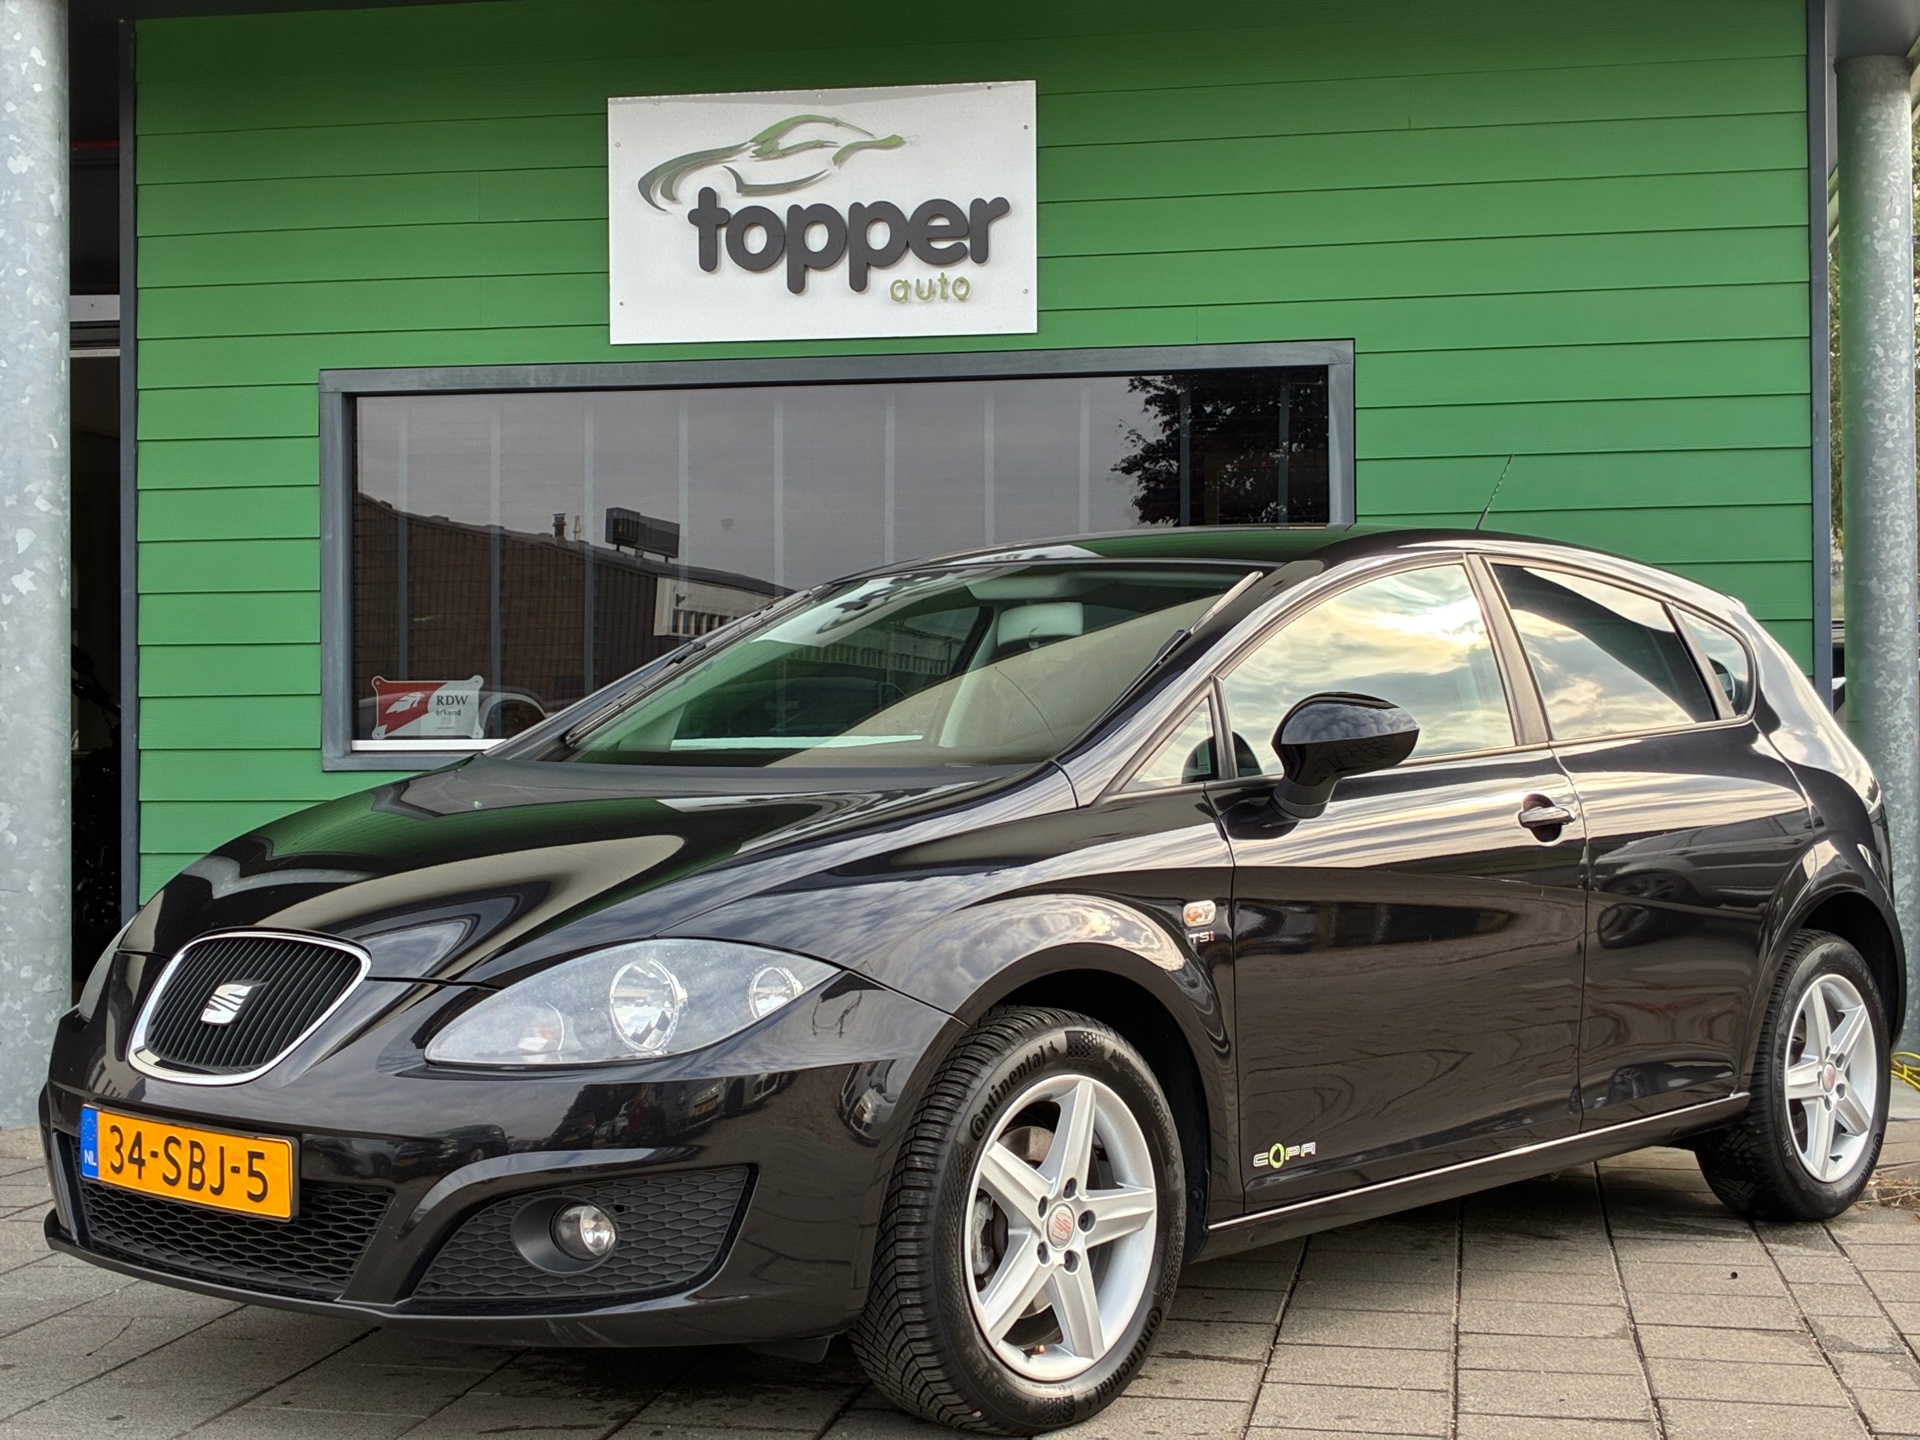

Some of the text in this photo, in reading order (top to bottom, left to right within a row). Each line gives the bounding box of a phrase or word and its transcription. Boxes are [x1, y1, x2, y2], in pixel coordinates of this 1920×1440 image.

[688, 187, 1011, 294] topper
[890, 272, 971, 301] auto
[436, 695, 468, 706] RDW
[436, 709, 462, 717] erkend
[970, 1043, 1048, 1141] Continental
[84, 1149, 98, 1167] NL
[109, 1124, 269, 1203] 34-SBJ-5
[1253, 1142, 1316, 1169] COPA
[1094, 1306, 1163, 1405] Continental
